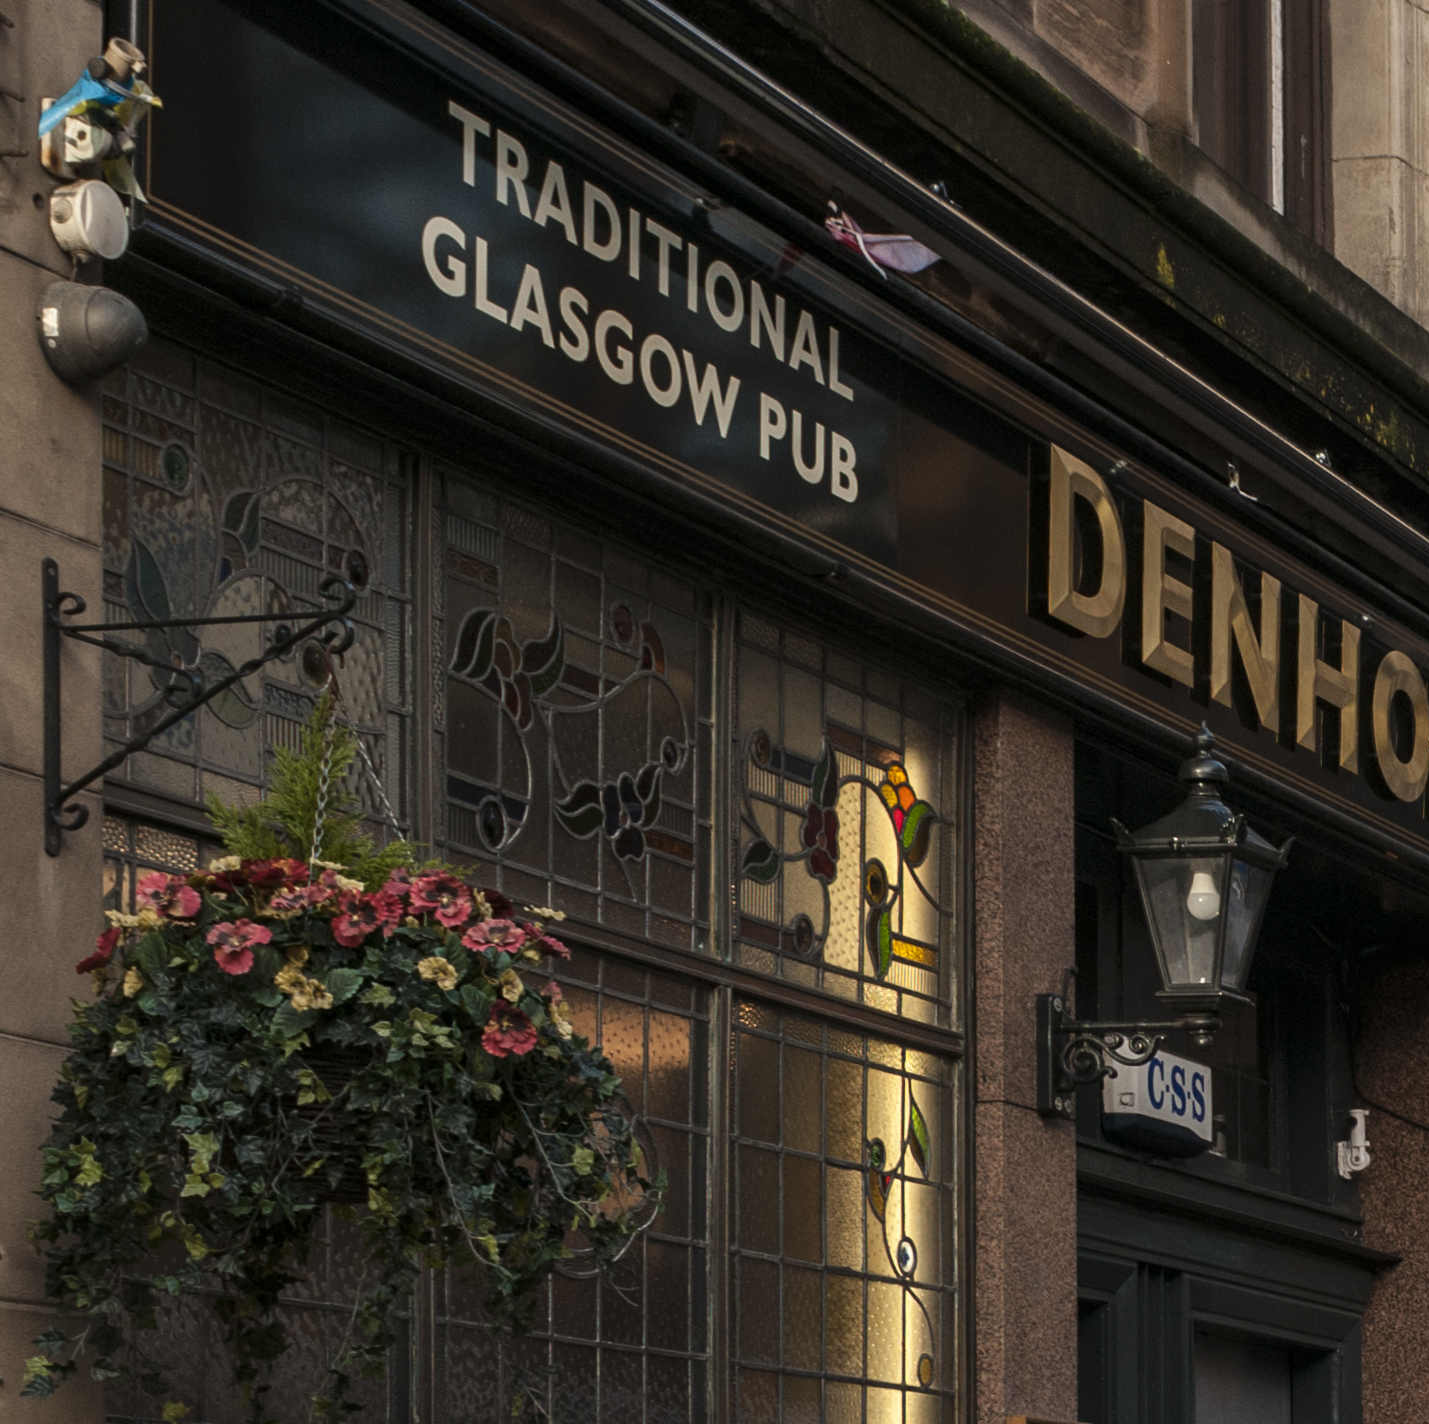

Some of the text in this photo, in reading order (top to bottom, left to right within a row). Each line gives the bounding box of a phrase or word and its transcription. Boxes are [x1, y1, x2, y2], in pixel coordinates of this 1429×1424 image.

[421, 215, 859, 503] GLASGOW PUB
[447, 100, 857, 401] TRADITIONAL
